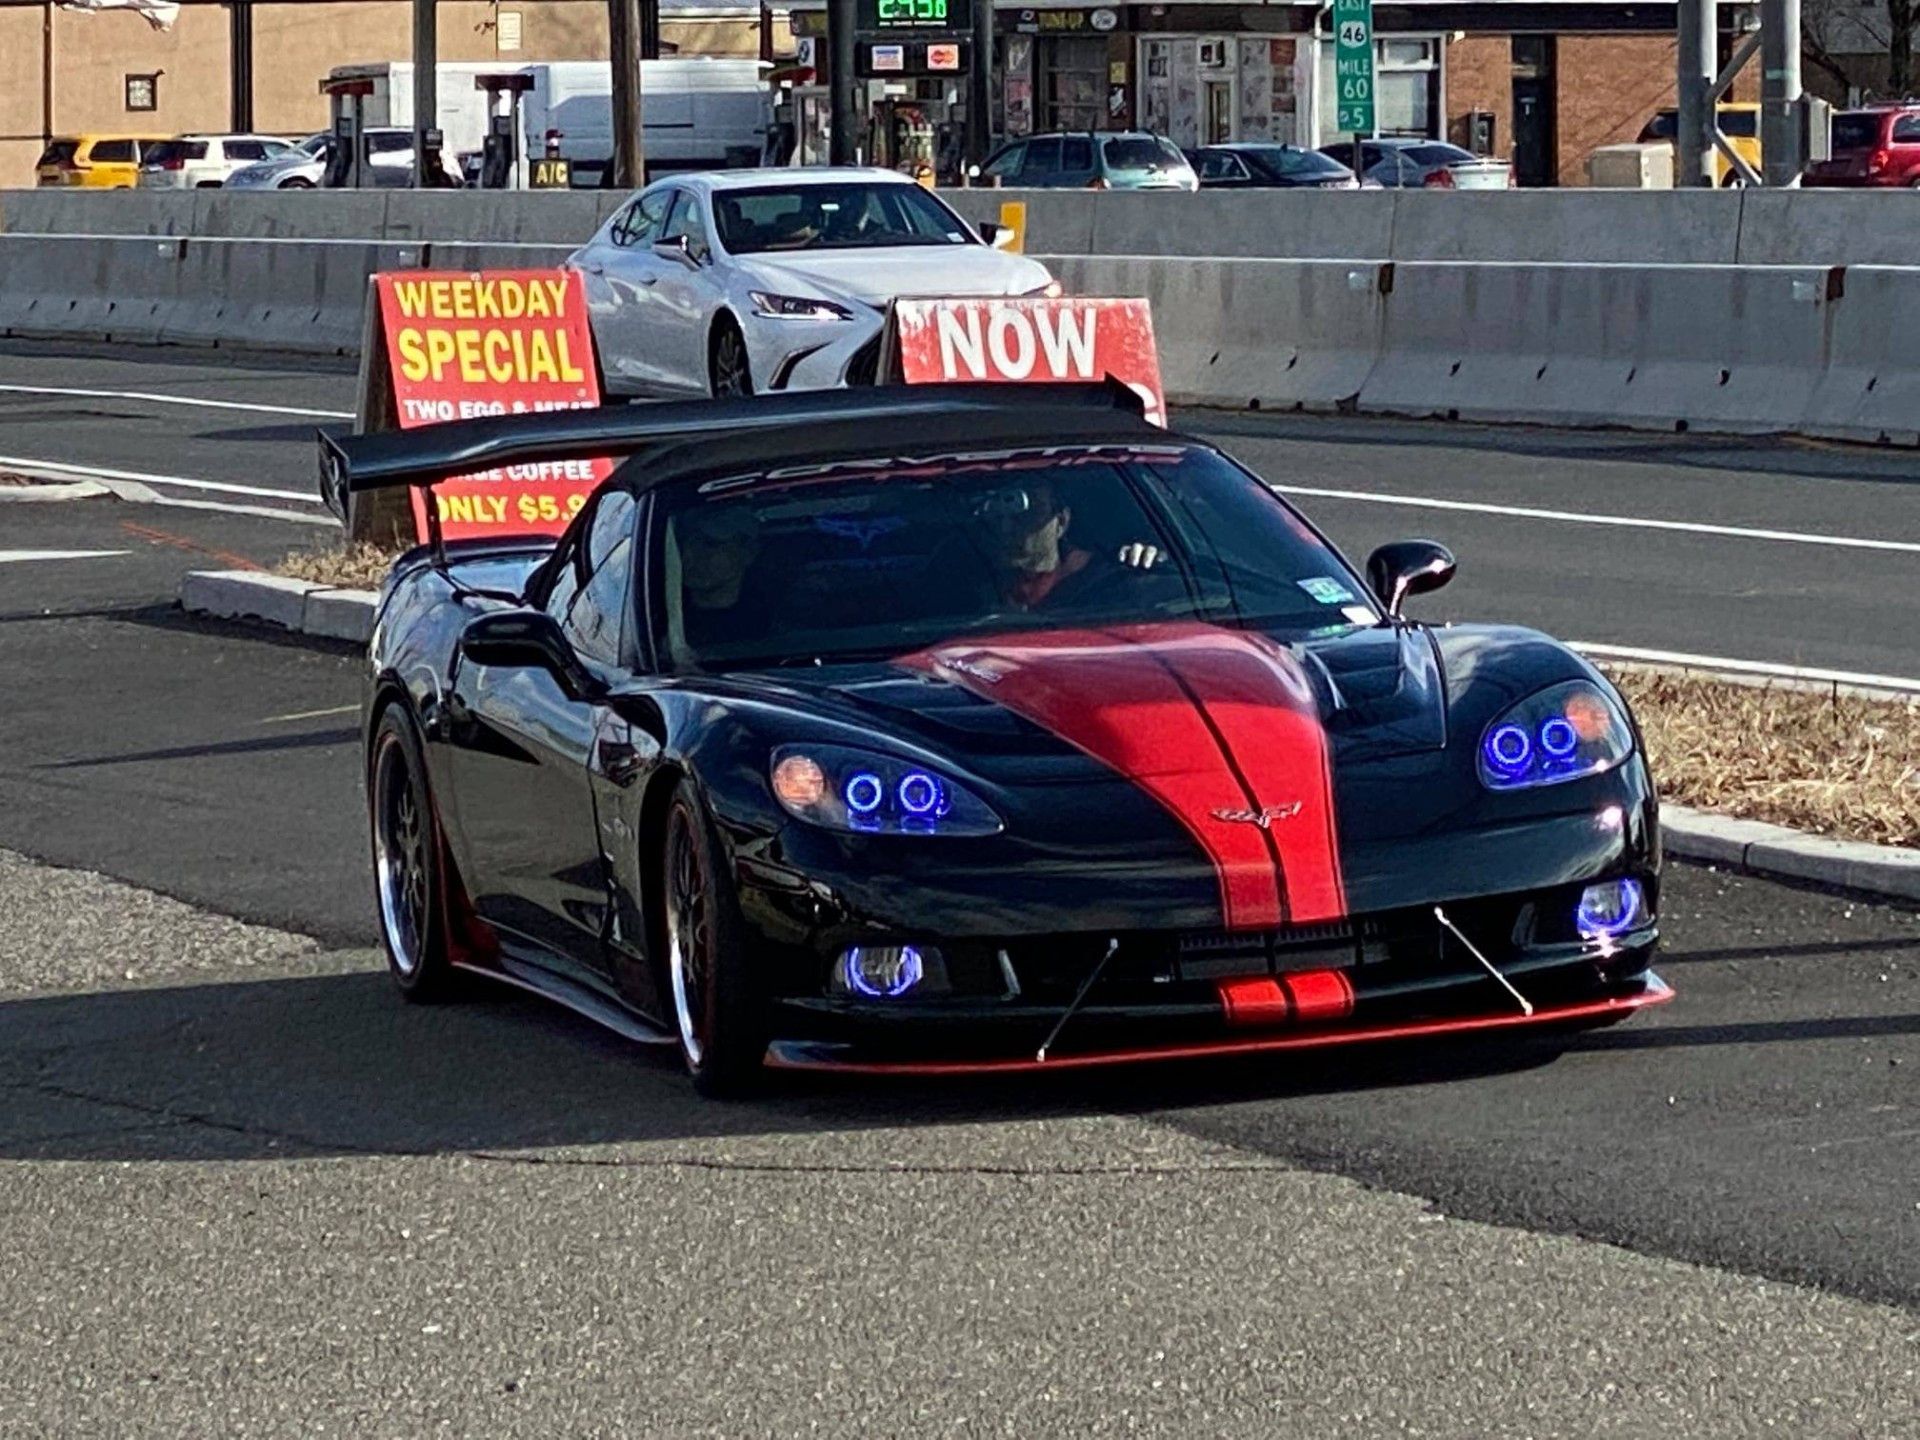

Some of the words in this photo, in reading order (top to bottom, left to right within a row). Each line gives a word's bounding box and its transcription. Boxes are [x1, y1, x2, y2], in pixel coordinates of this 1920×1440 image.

[1342, 27, 1365, 42] 46
[1338, 59, 1370, 76] MILE
[1343, 78, 1368, 99] 60
[394, 280, 569, 319] WEEKDAY
[937, 304, 1097, 380] NOW
[398, 328, 584, 384] SPECIAL
[402, 399, 455, 421] TWO
[506, 460, 595, 481] COFFEE
